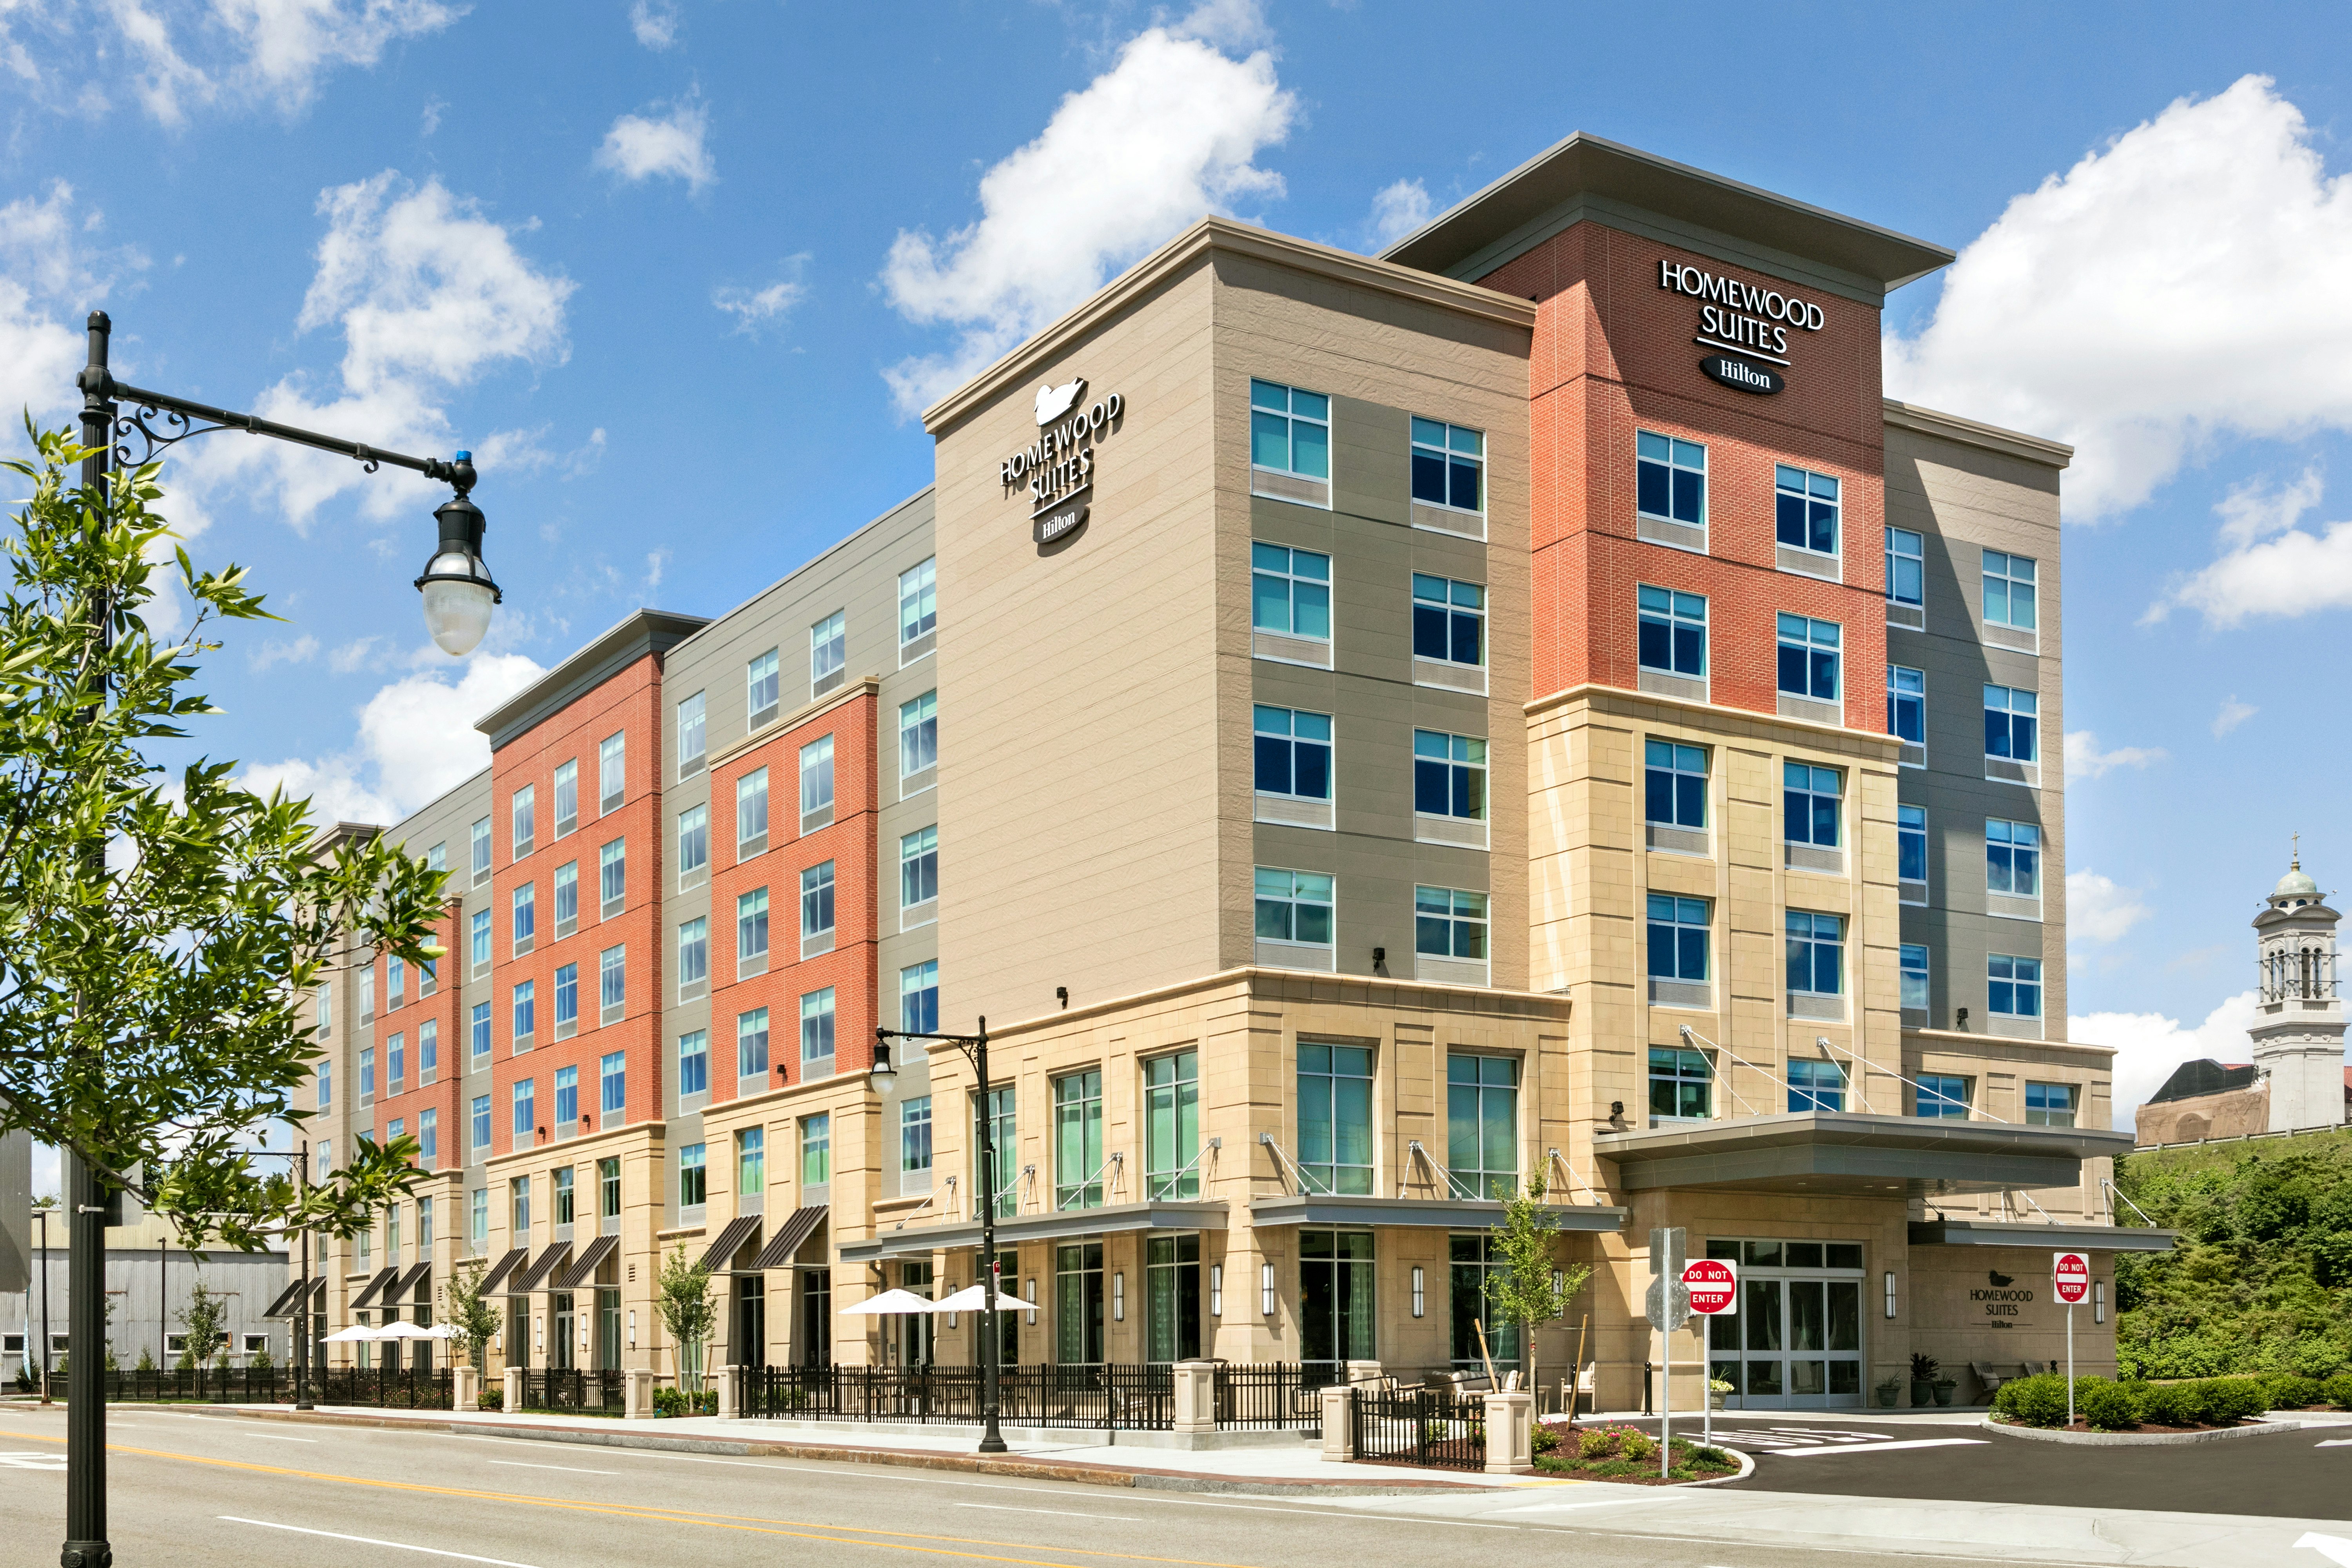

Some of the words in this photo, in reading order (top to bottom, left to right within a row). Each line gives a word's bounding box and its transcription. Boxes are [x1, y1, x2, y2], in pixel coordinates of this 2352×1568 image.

[1661, 260, 1824, 330] HOMEWOOD
[1702, 305, 1787, 354] SUITES
[1720, 359, 1771, 389] Hilton
[1000, 392, 1122, 486] HOMEWOOD
[1029, 448, 1091, 504] SUITES
[1043, 511, 1076, 539] Hilton
[2060, 1263, 2068, 1271] DO
[2071, 1263, 2083, 1272] NOT
[1689, 1270, 1702, 1279] DO
[1708, 1270, 1727, 1279] NOT
[1970, 1289, 2033, 1301] HOMEWOOD
[2062, 1285, 2082, 1293] ENTER
[1692, 1294, 1723, 1303] ENTER
[1985, 1304, 2018, 1316] SUITES
[1991, 1320, 2013, 1328] Hilton
